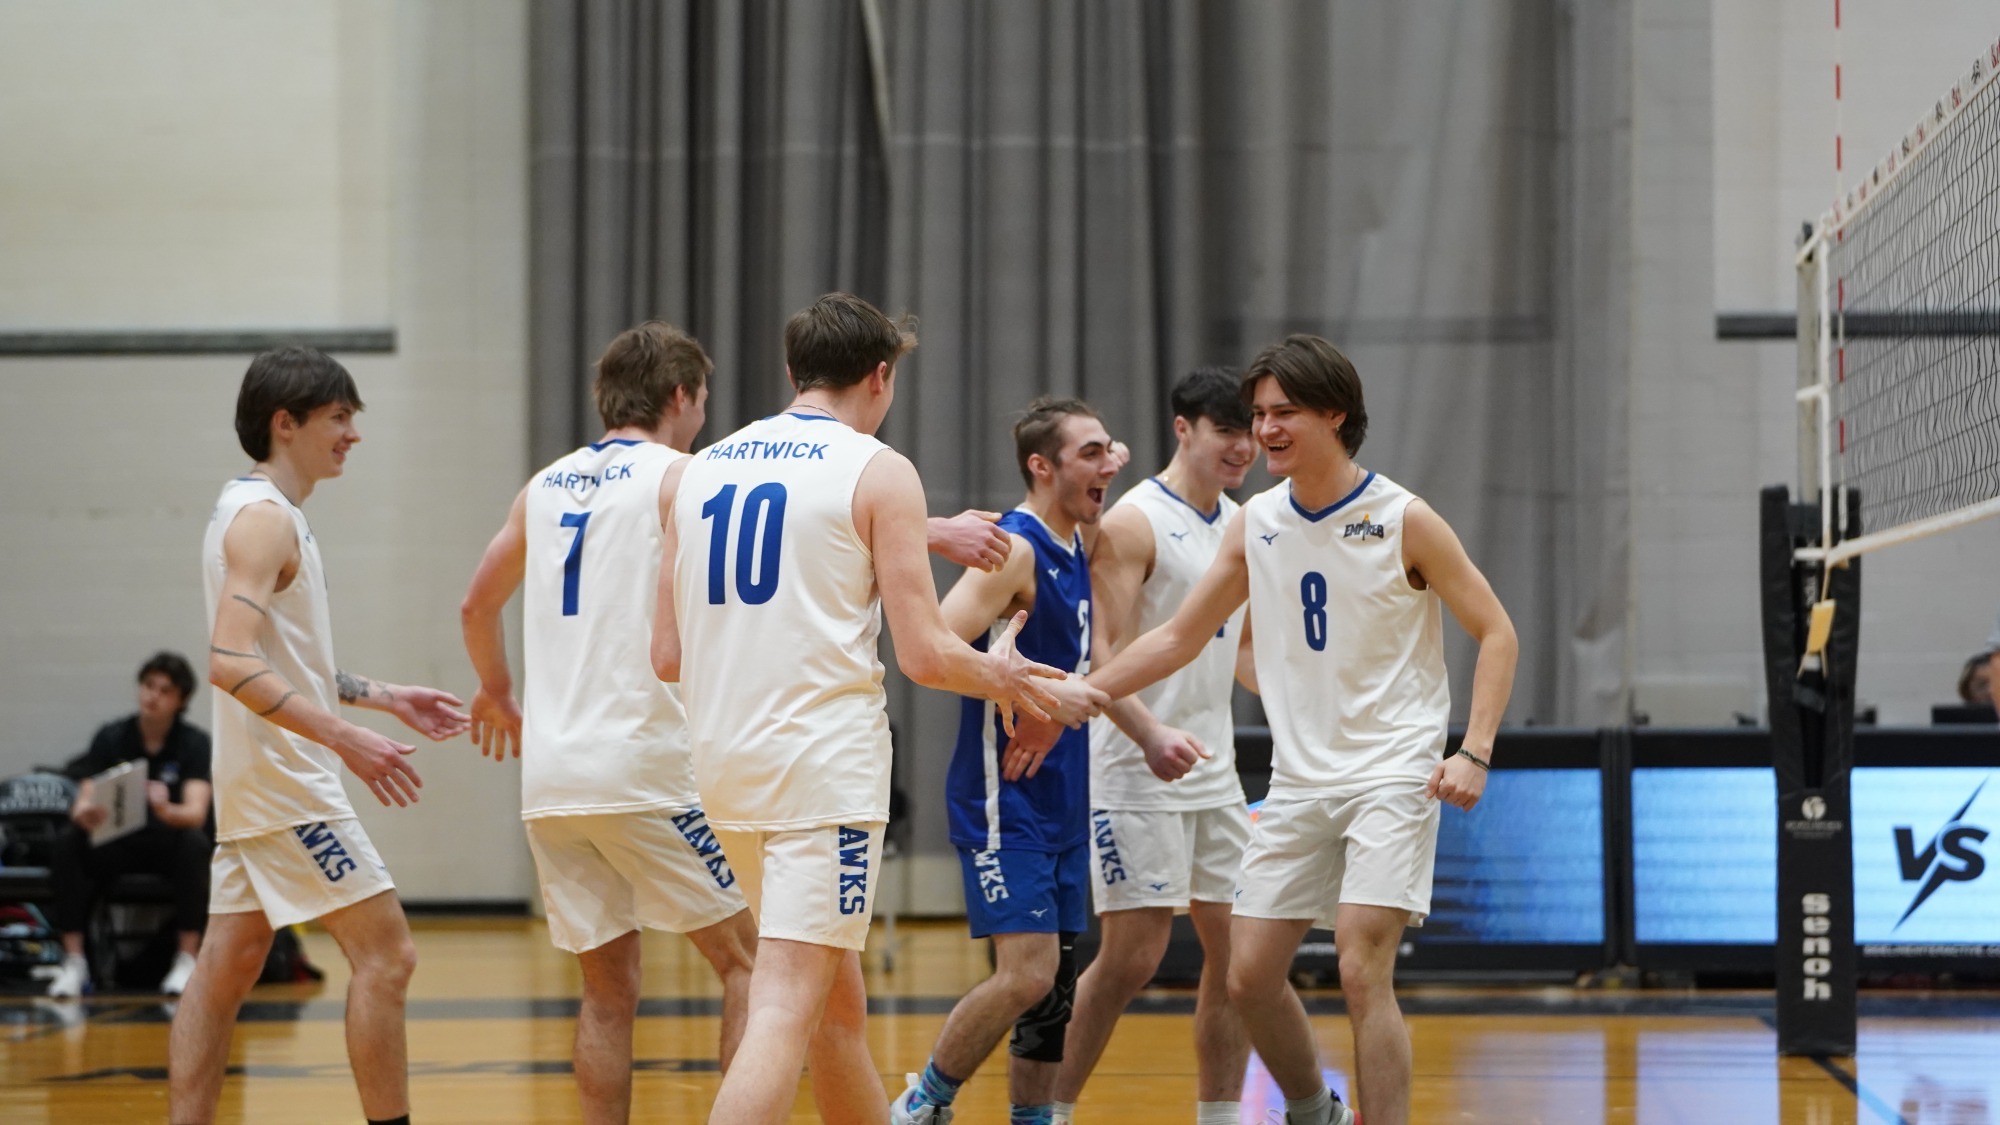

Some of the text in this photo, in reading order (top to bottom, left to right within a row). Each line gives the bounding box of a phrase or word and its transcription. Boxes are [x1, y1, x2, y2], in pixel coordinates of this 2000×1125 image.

[543, 464, 634, 493] HARTWCK
[706, 441, 829, 461] HARTWICK
[560, 511, 592, 616] 7
[702, 482, 787, 605] 10
[1301, 571, 1327, 651] 8
[671, 810, 735, 889] HAWKS
[839, 821, 869, 915] AWKS
[972, 849, 1009, 903] WKS
[1893, 824, 1990, 882] VS
